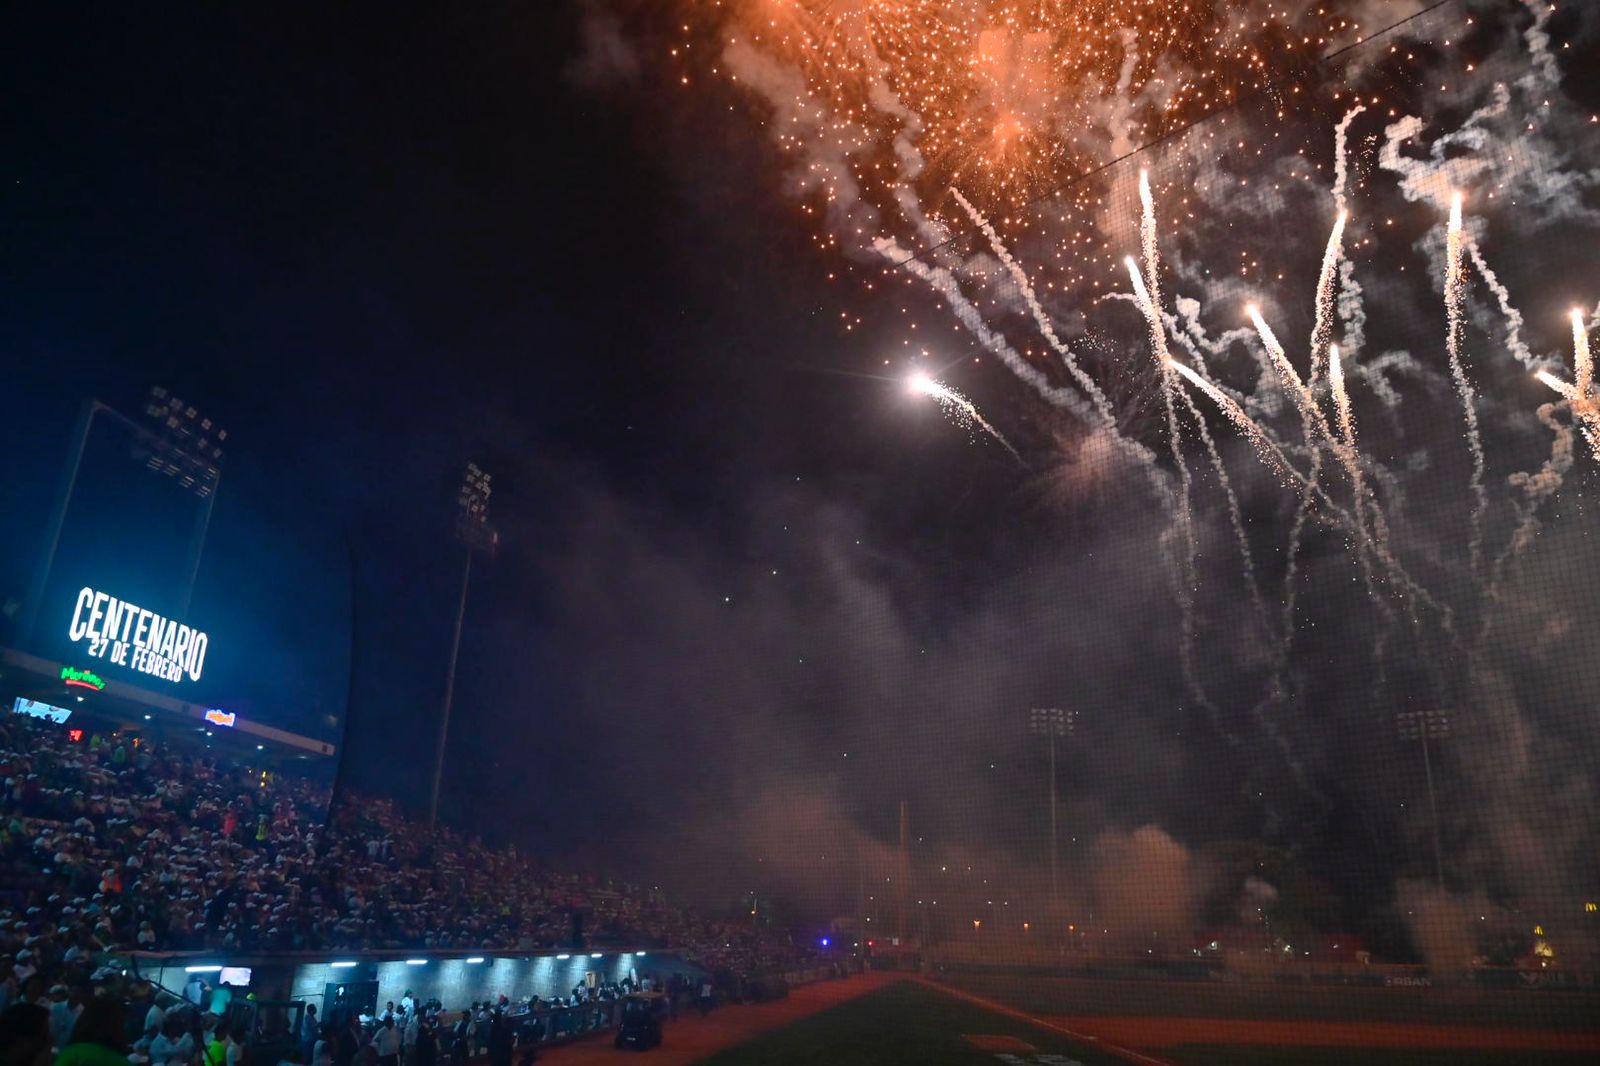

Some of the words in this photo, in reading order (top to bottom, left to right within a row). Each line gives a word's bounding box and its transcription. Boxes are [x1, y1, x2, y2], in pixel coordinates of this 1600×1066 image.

[69, 587, 208, 682] CENTENARIO
[88, 638, 109, 658] 27
[110, 641, 130, 666] DE
[131, 646, 182, 683] FEBRERO
